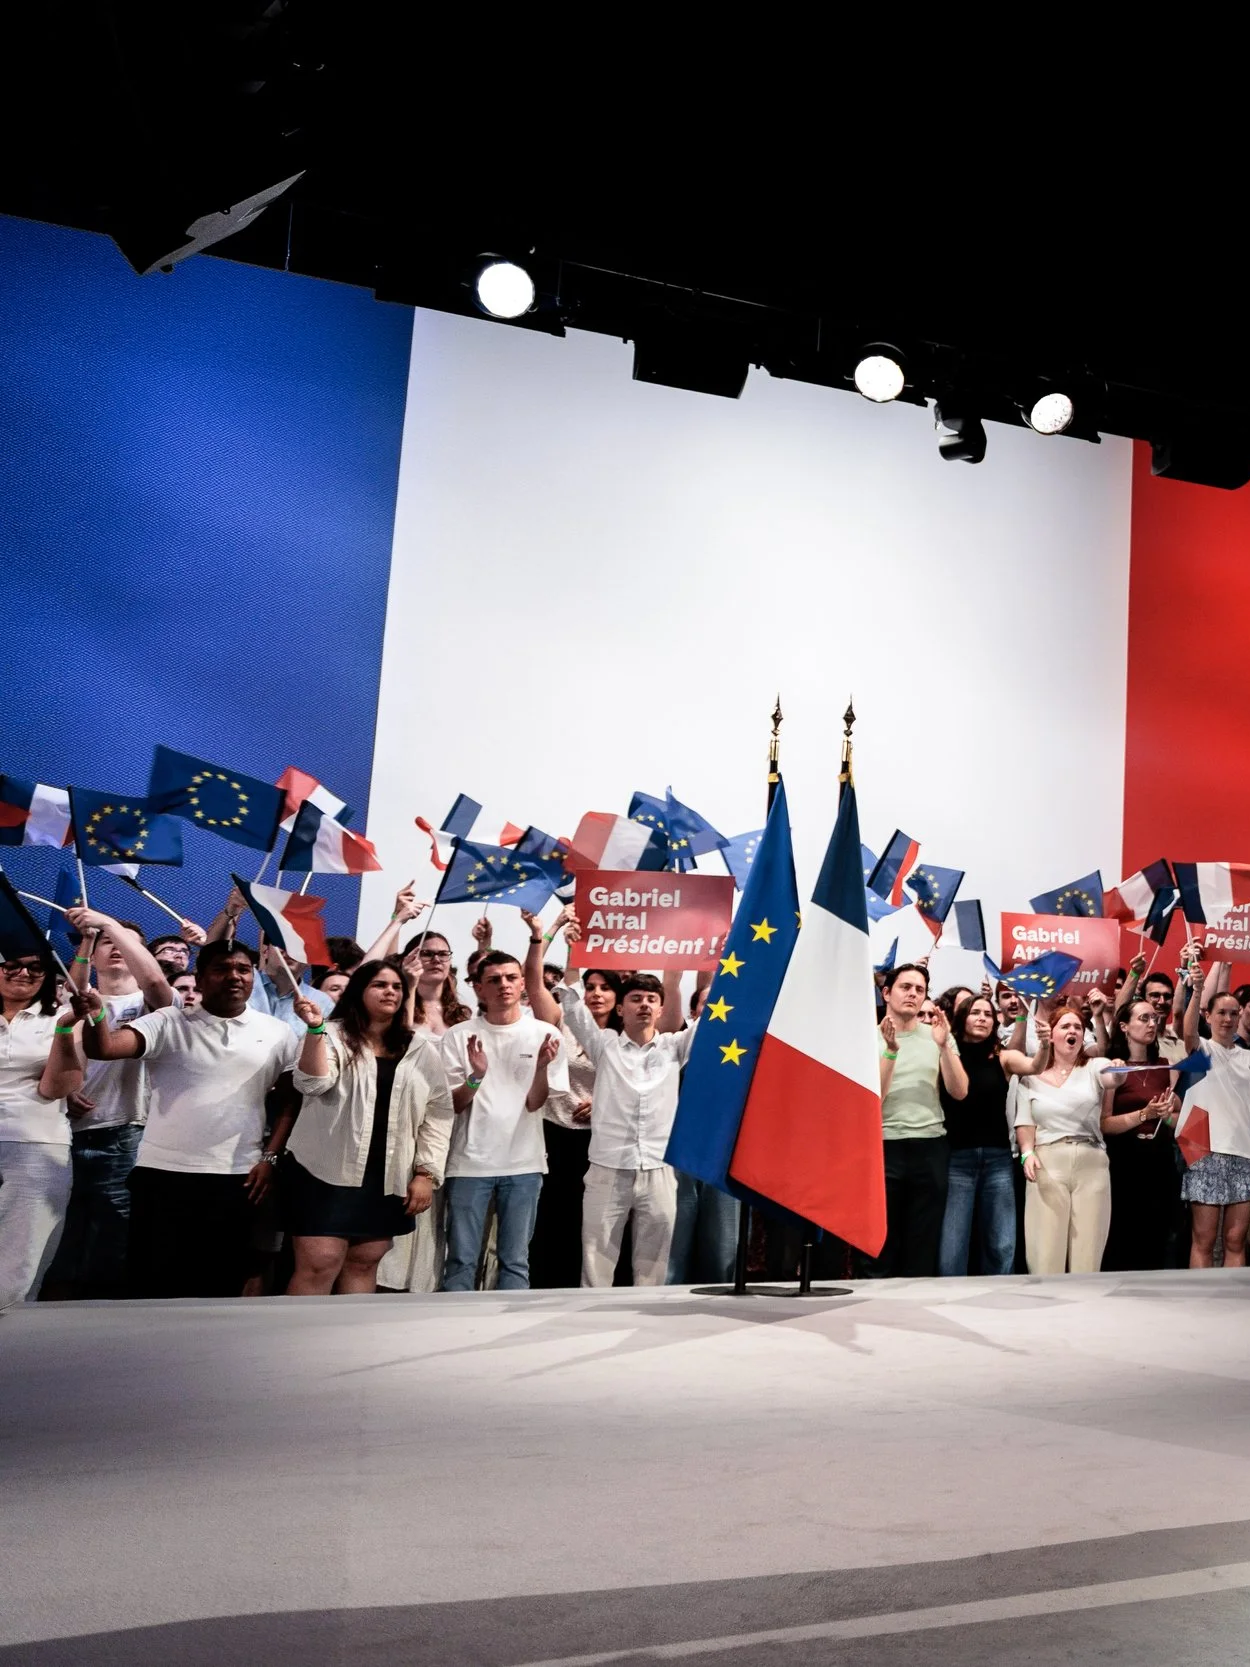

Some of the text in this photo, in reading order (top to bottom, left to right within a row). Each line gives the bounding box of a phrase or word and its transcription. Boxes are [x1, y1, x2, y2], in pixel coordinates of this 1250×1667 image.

[589, 886, 681, 908] Gabriel
[587, 911, 647, 930] Attal
[585, 934, 719, 955] Président !
[1011, 925, 1080, 945] Gabriel
[1012, 943, 1056, 961] Att
